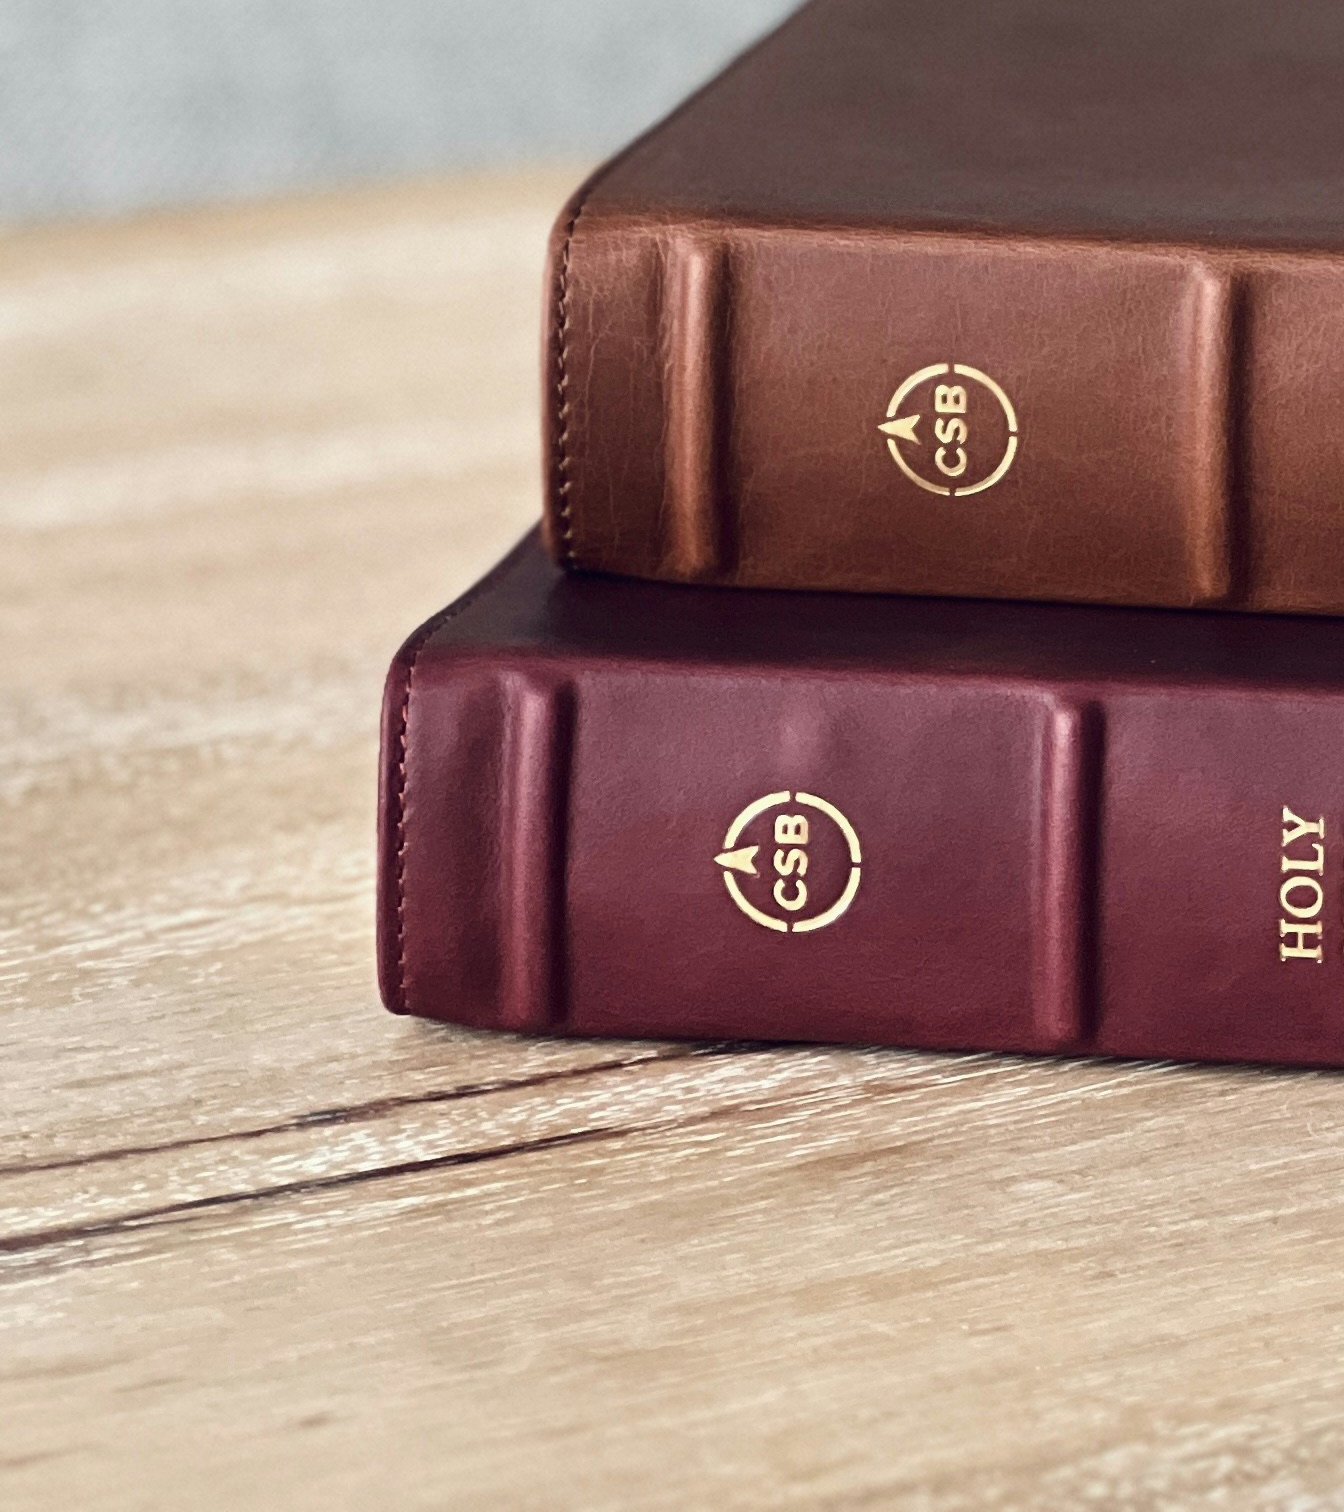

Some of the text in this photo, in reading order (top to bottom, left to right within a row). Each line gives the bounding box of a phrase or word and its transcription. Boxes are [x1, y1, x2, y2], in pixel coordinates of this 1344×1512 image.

[935, 384, 968, 477] CSB
[773, 814, 809, 911] CSB
[1279, 805, 1325, 964] HOLY
